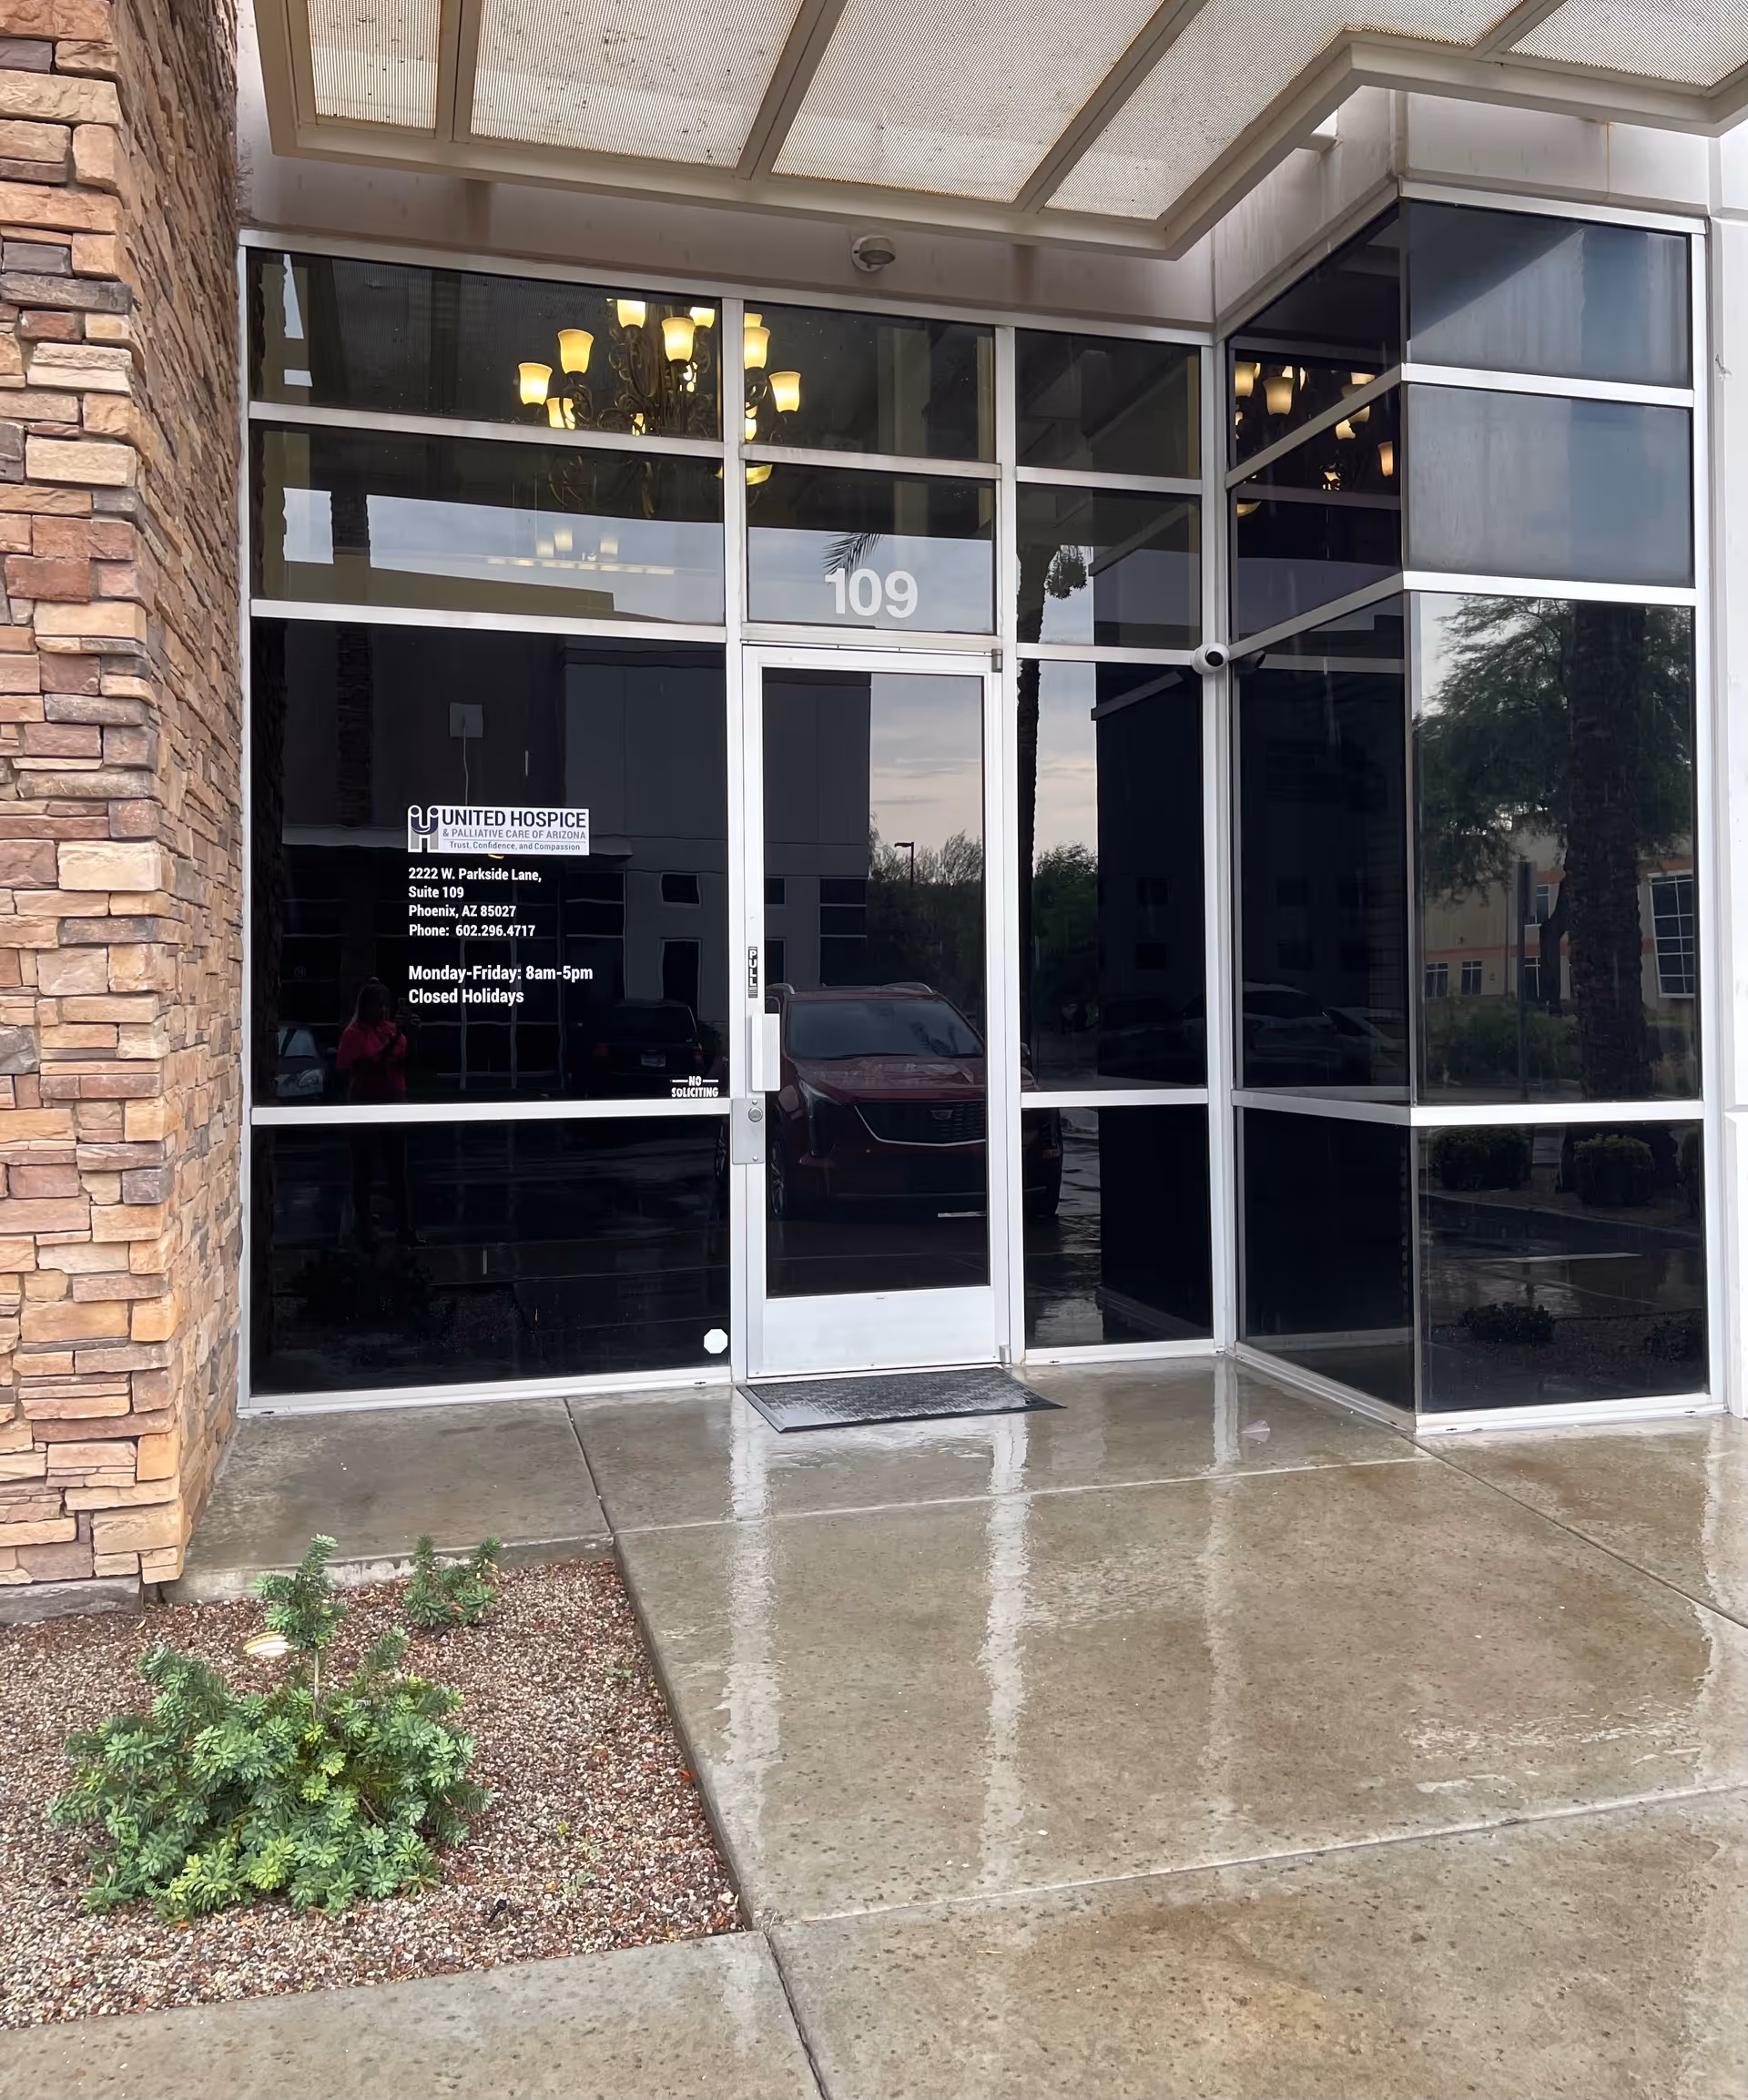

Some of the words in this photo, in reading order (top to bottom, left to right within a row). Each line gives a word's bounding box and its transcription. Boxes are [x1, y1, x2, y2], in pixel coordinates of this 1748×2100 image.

[825, 568, 918, 618] 109
[442, 809, 505, 827] UNITED
[510, 811, 585, 827] HOSPICE
[442, 828, 449, 837] &
[452, 828, 503, 837] PALLIATIVE
[505, 830, 530, 838] CARE
[532, 830, 544, 838] OF
[546, 831, 585, 839] ARIZONA
[450, 841, 471, 849] Trust,
[473, 841, 517, 850] Confidence,
[534, 843, 580, 851] Compassion
[409, 867, 439, 879] 2222
[441, 868, 455, 879] W.
[459, 868, 509, 880] Parkside
[512, 869, 542, 882] Lane,
[409, 887, 440, 898] Suite
[442, 887, 464, 898] 109
[409, 905, 459, 918] Phoenix,
[462, 906, 477, 917] AZ
[481, 906, 517, 917] 85027
[409, 924, 450, 936] Phone:
[456, 925, 535, 937] 602.296.4717
[409, 965, 522, 983] Monday-Friday:
[525, 965, 593, 982] 8am-5pm
[409, 989, 458, 1003] Closed
[462, 989, 524, 1006] Holidays
[688, 1076, 702, 1086] NO
[672, 1087, 719, 1098] SOLICITING
